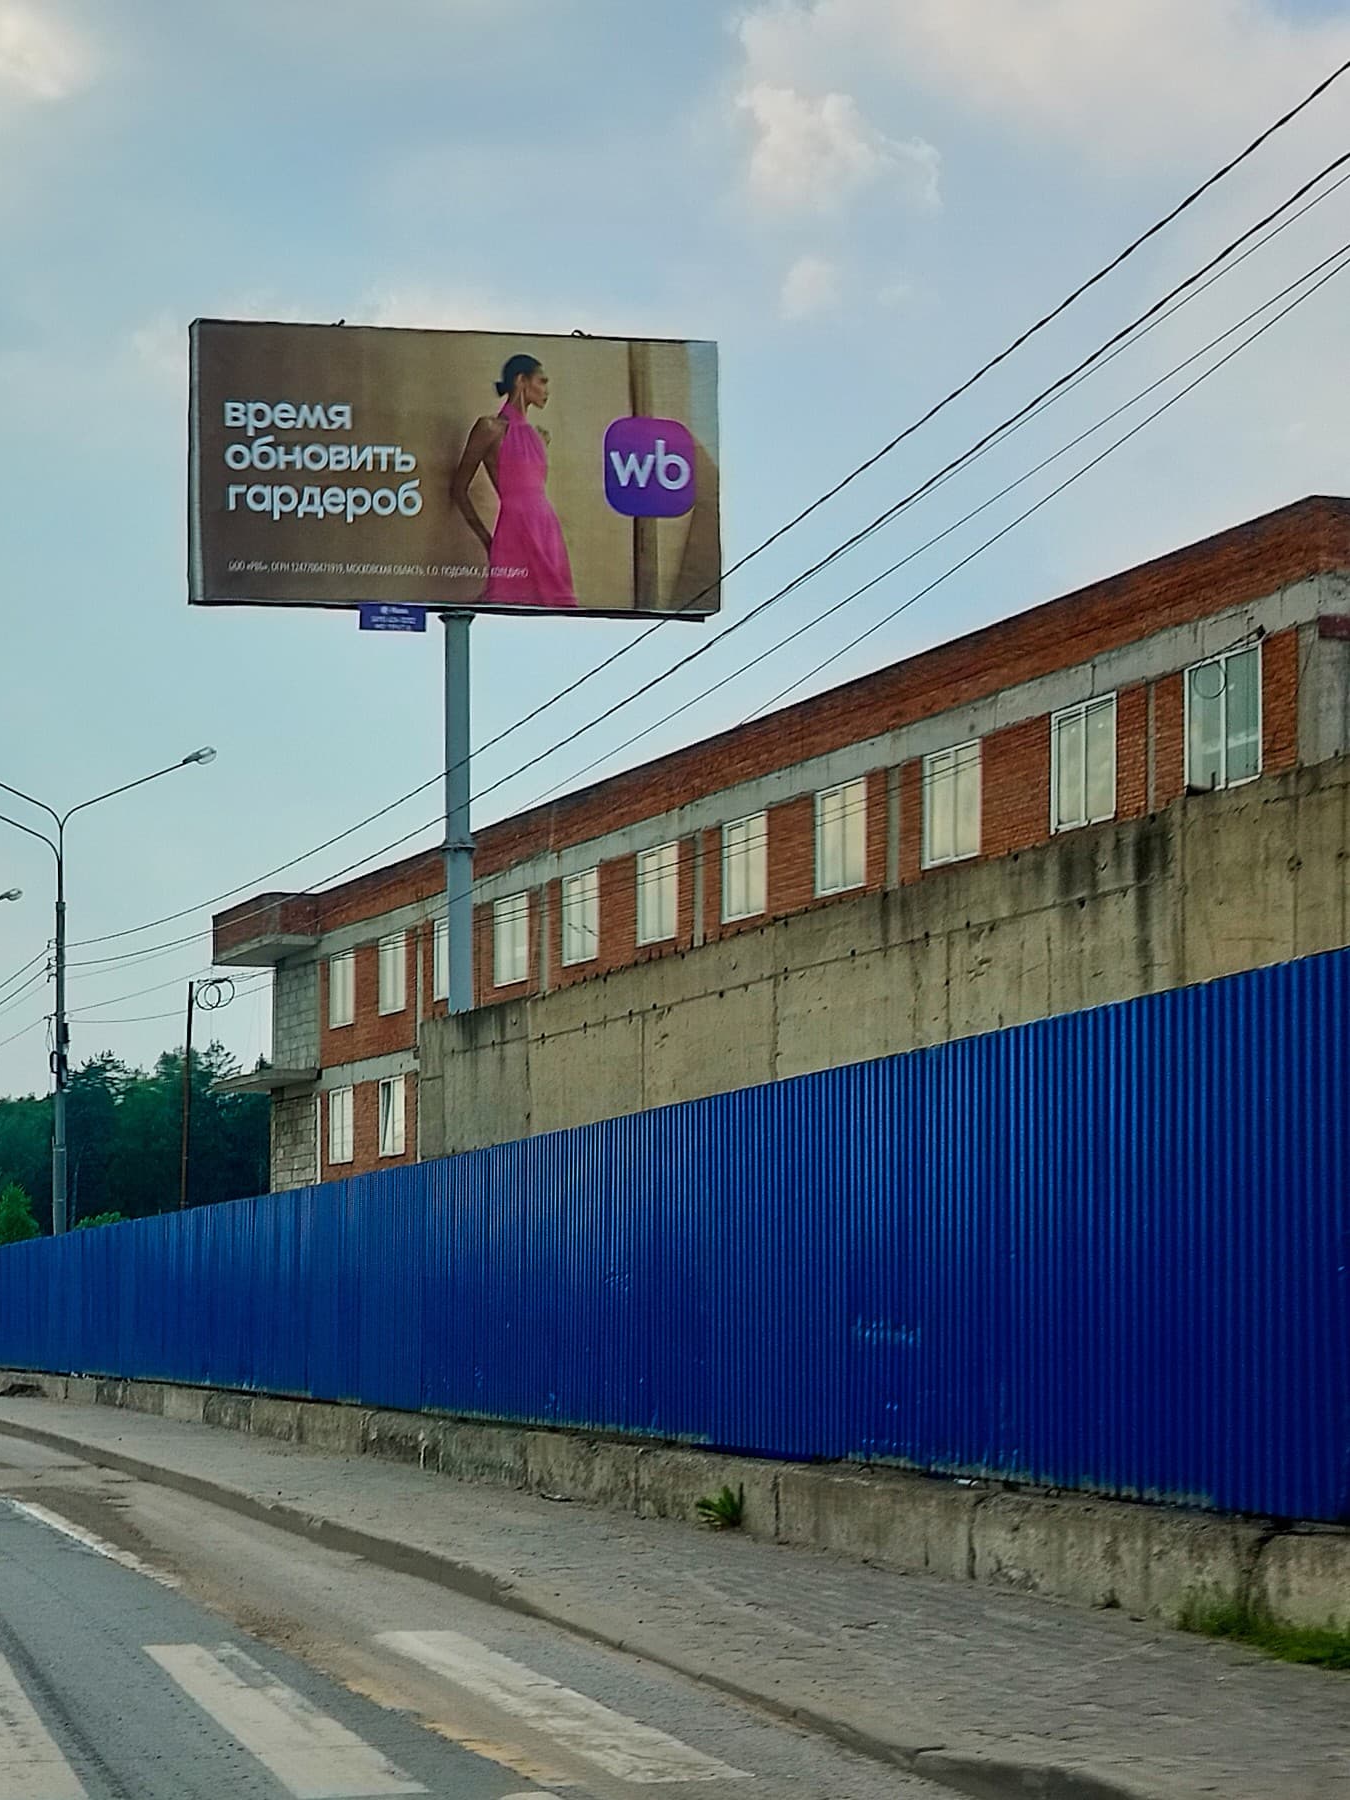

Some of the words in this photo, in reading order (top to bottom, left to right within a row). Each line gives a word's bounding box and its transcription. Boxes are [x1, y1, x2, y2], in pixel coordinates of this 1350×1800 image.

[224, 401, 352, 437] время
[224, 434, 417, 473] обновить
[609, 439, 691, 491] wb
[227, 478, 423, 523] гардероб
